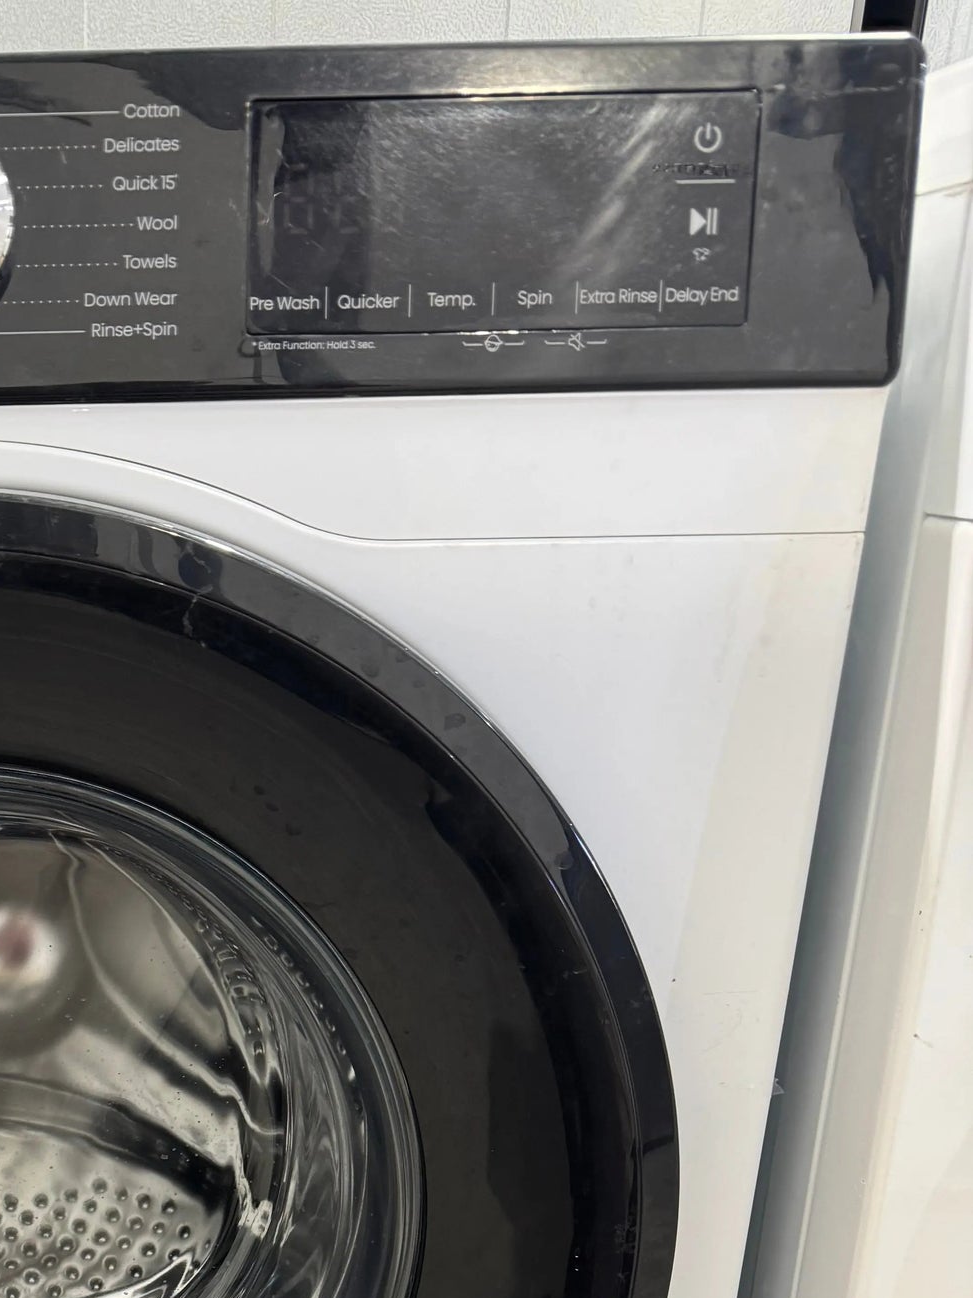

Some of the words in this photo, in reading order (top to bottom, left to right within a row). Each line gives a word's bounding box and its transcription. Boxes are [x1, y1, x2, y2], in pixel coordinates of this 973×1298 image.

[123, 103, 180, 119] Cotton
[103, 137, 180, 154] Delicates
[112, 174, 158, 191] Quick
[137, 215, 178, 231] Wool
[122, 253, 177, 269] Towels
[84, 292, 131, 308] Down
[134, 291, 178, 307] Wear
[249, 296, 274, 311] Pre
[276, 295, 320, 310] Wash
[337, 293, 400, 310] Quicker
[427, 291, 476, 310] Temp.
[517, 289, 553, 309] Spin
[580, 289, 615, 304] Extra
[619, 288, 658, 304] Rinse
[665, 287, 708, 306] Delay
[710, 286, 739, 302] End
[91, 321, 178, 339] Rinse+Spin
[258, 341, 281, 351] Extra
[326, 340, 348, 350] Hold
[349, 340, 356, 349] 3
